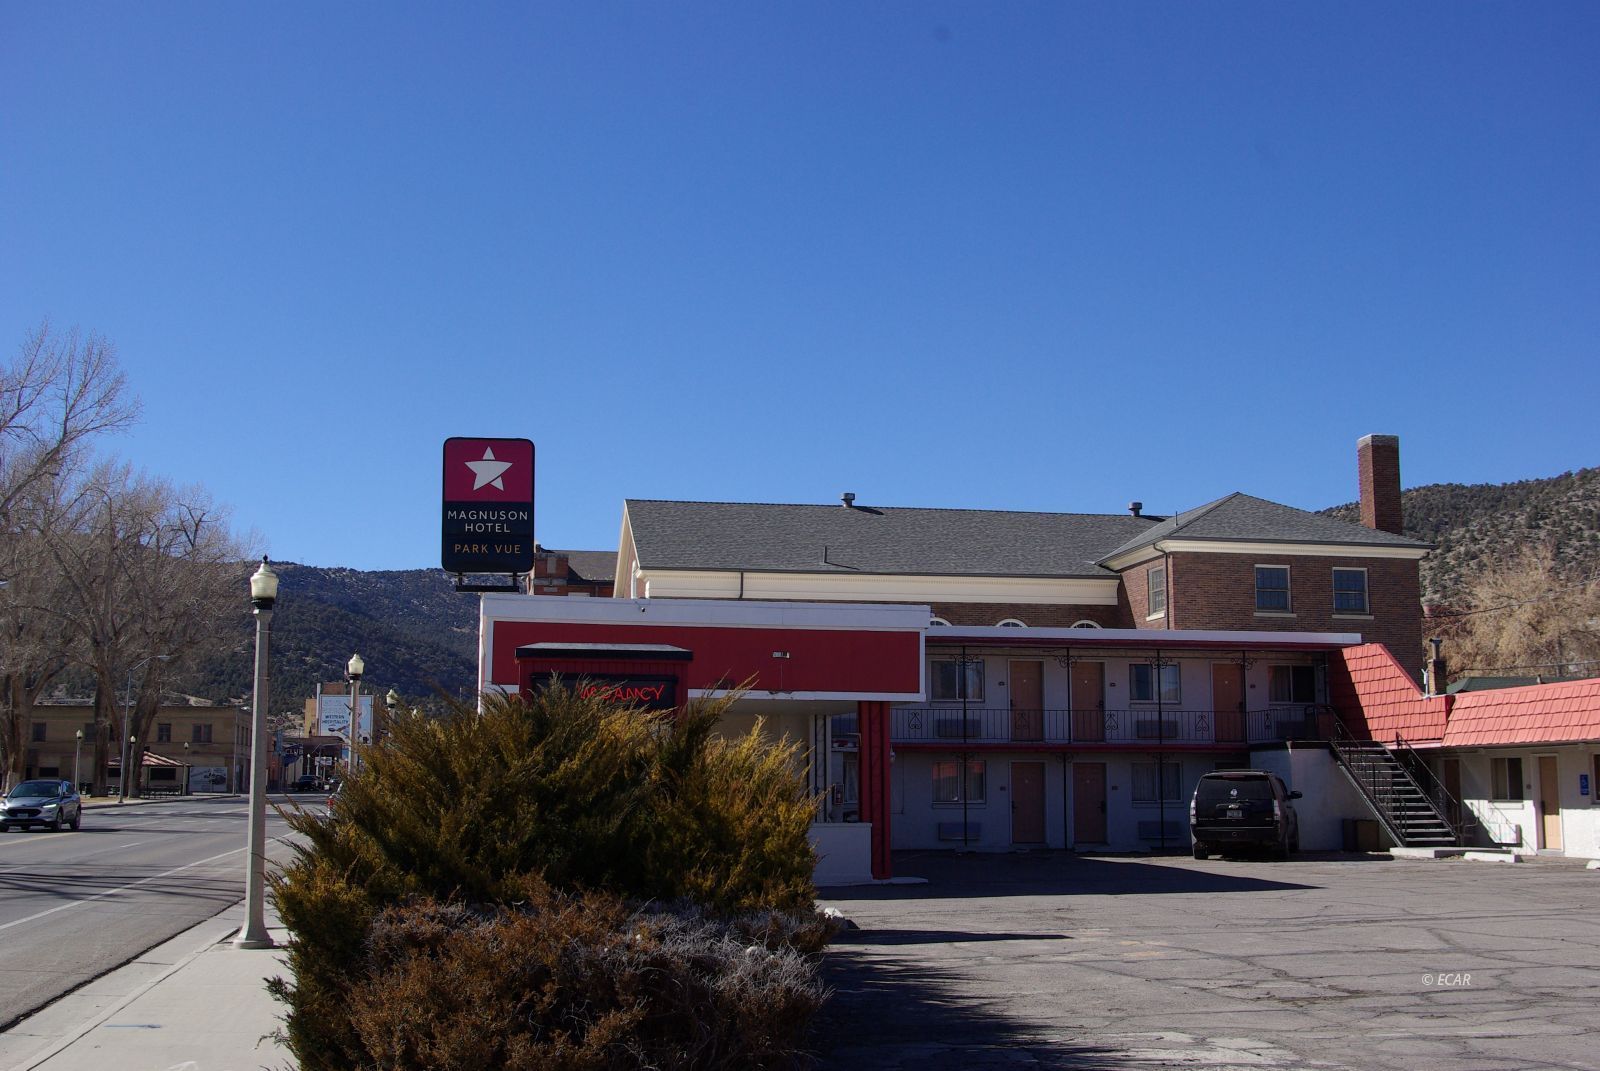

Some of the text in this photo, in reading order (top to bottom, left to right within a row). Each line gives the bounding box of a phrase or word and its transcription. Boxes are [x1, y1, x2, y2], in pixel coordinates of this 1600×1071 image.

[447, 510, 528, 521] MAGNUSON
[465, 523, 511, 533] HOTEL
[454, 544, 521, 554] PARK VUE
